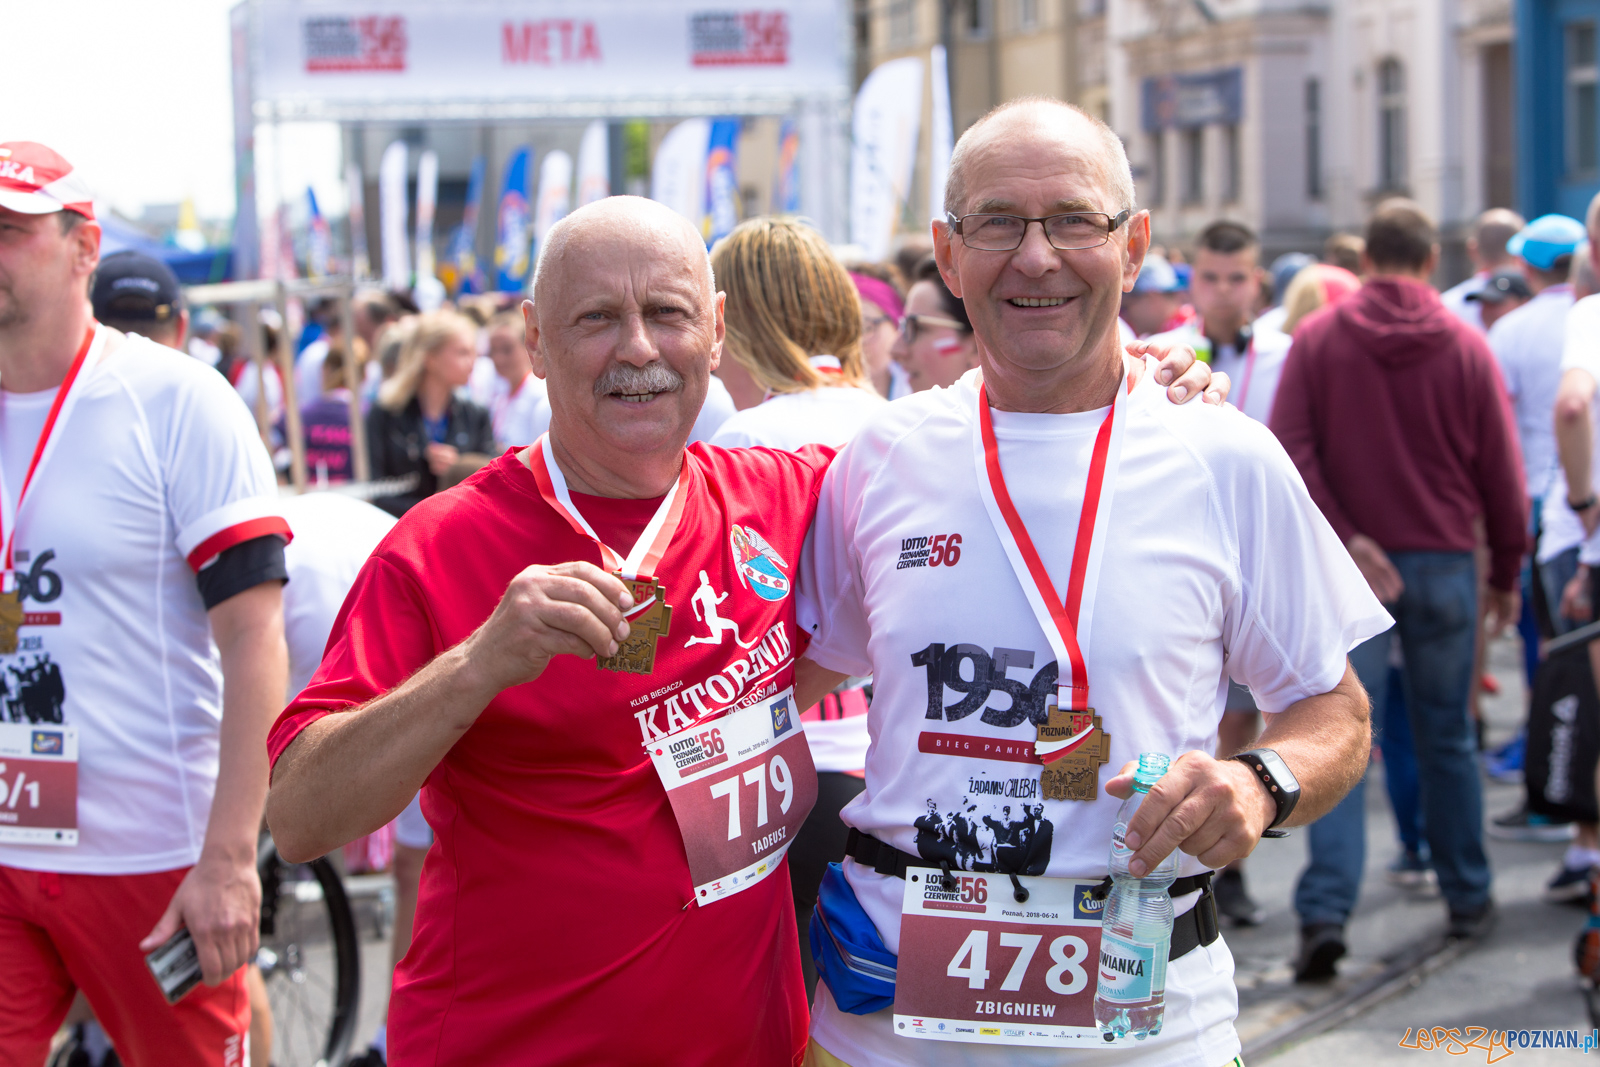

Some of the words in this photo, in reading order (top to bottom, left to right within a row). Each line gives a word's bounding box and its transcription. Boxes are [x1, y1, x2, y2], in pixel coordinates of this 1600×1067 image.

[501, 20, 603, 63] META
[0, 160, 35, 184] KA
[902, 536, 928, 551] LOTTO
[928, 533, 962, 567] '56
[896, 558, 928, 570] CZERWIEC
[629, 694, 649, 708] KLUB
[650, 680, 684, 699] BIEGACZA
[1040, 725, 1072, 737] POZNAŃ
[669, 737, 695, 754] LOTTO
[694, 728, 725, 758] '56
[672, 745, 703, 761] POZNAŃSKI
[936, 739, 969, 750] BIEG
[984, 744, 1029, 757] PAMIĘ
[675, 752, 705, 769] CZERWIEC
[709, 754, 794, 841] 779
[968, 776, 1004, 797] ŻĄDAMY
[1004, 778, 1037, 799] CHLEBA
[752, 825, 787, 855] TADEUSZ
[923, 891, 960, 901] CZERWIEC
[1001, 909, 1025, 918] Poznań,
[1026, 911, 1059, 919] 2018-06-24
[946, 929, 1089, 995] 478
[975, 1000, 1057, 1018] ZBIGNIEW
